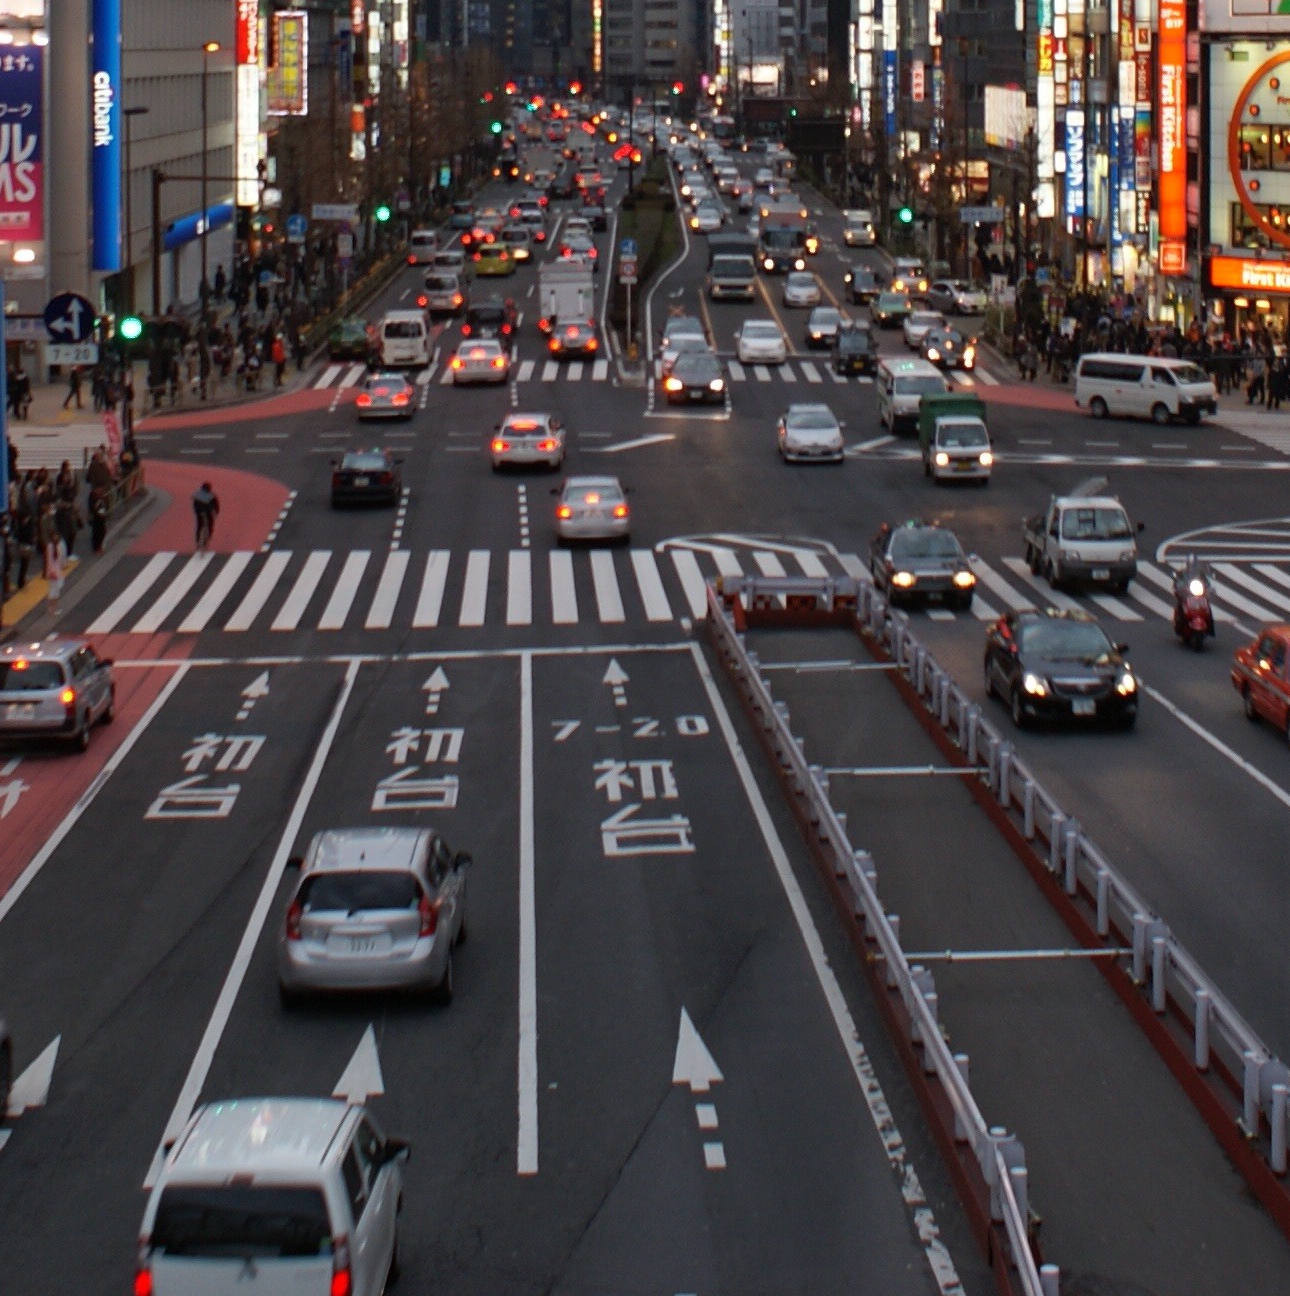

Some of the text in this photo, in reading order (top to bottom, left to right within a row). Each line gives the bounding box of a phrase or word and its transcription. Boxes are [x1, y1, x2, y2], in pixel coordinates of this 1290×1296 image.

[93, 70, 114, 147] citibank
[1162, 64, 1176, 173] First Kitchen
[1242, 268, 1274, 288] First
[52, 345, 93, 361] 7-20
[370, 725, 465, 812] 初台
[551, 714, 711, 742] 7-20
[143, 733, 267, 820] 初台
[594, 757, 696, 857] 初台
